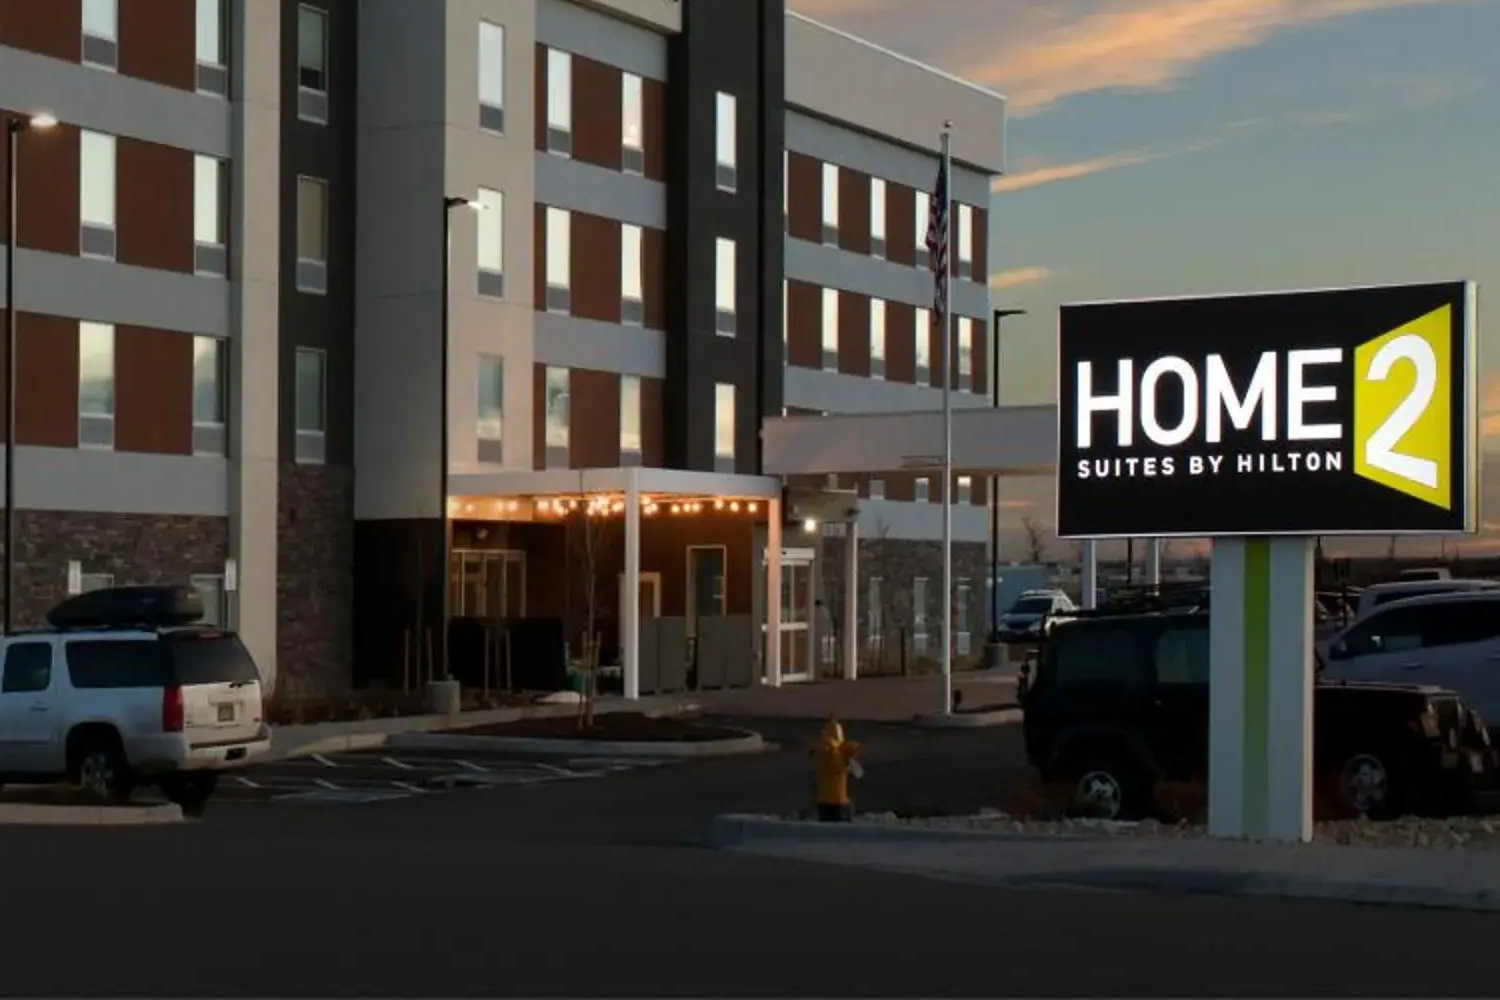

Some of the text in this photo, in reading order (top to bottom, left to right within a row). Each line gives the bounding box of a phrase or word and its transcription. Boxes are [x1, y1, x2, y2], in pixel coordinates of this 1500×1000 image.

[1077, 451, 1343, 479] SUITES BY HILTON
